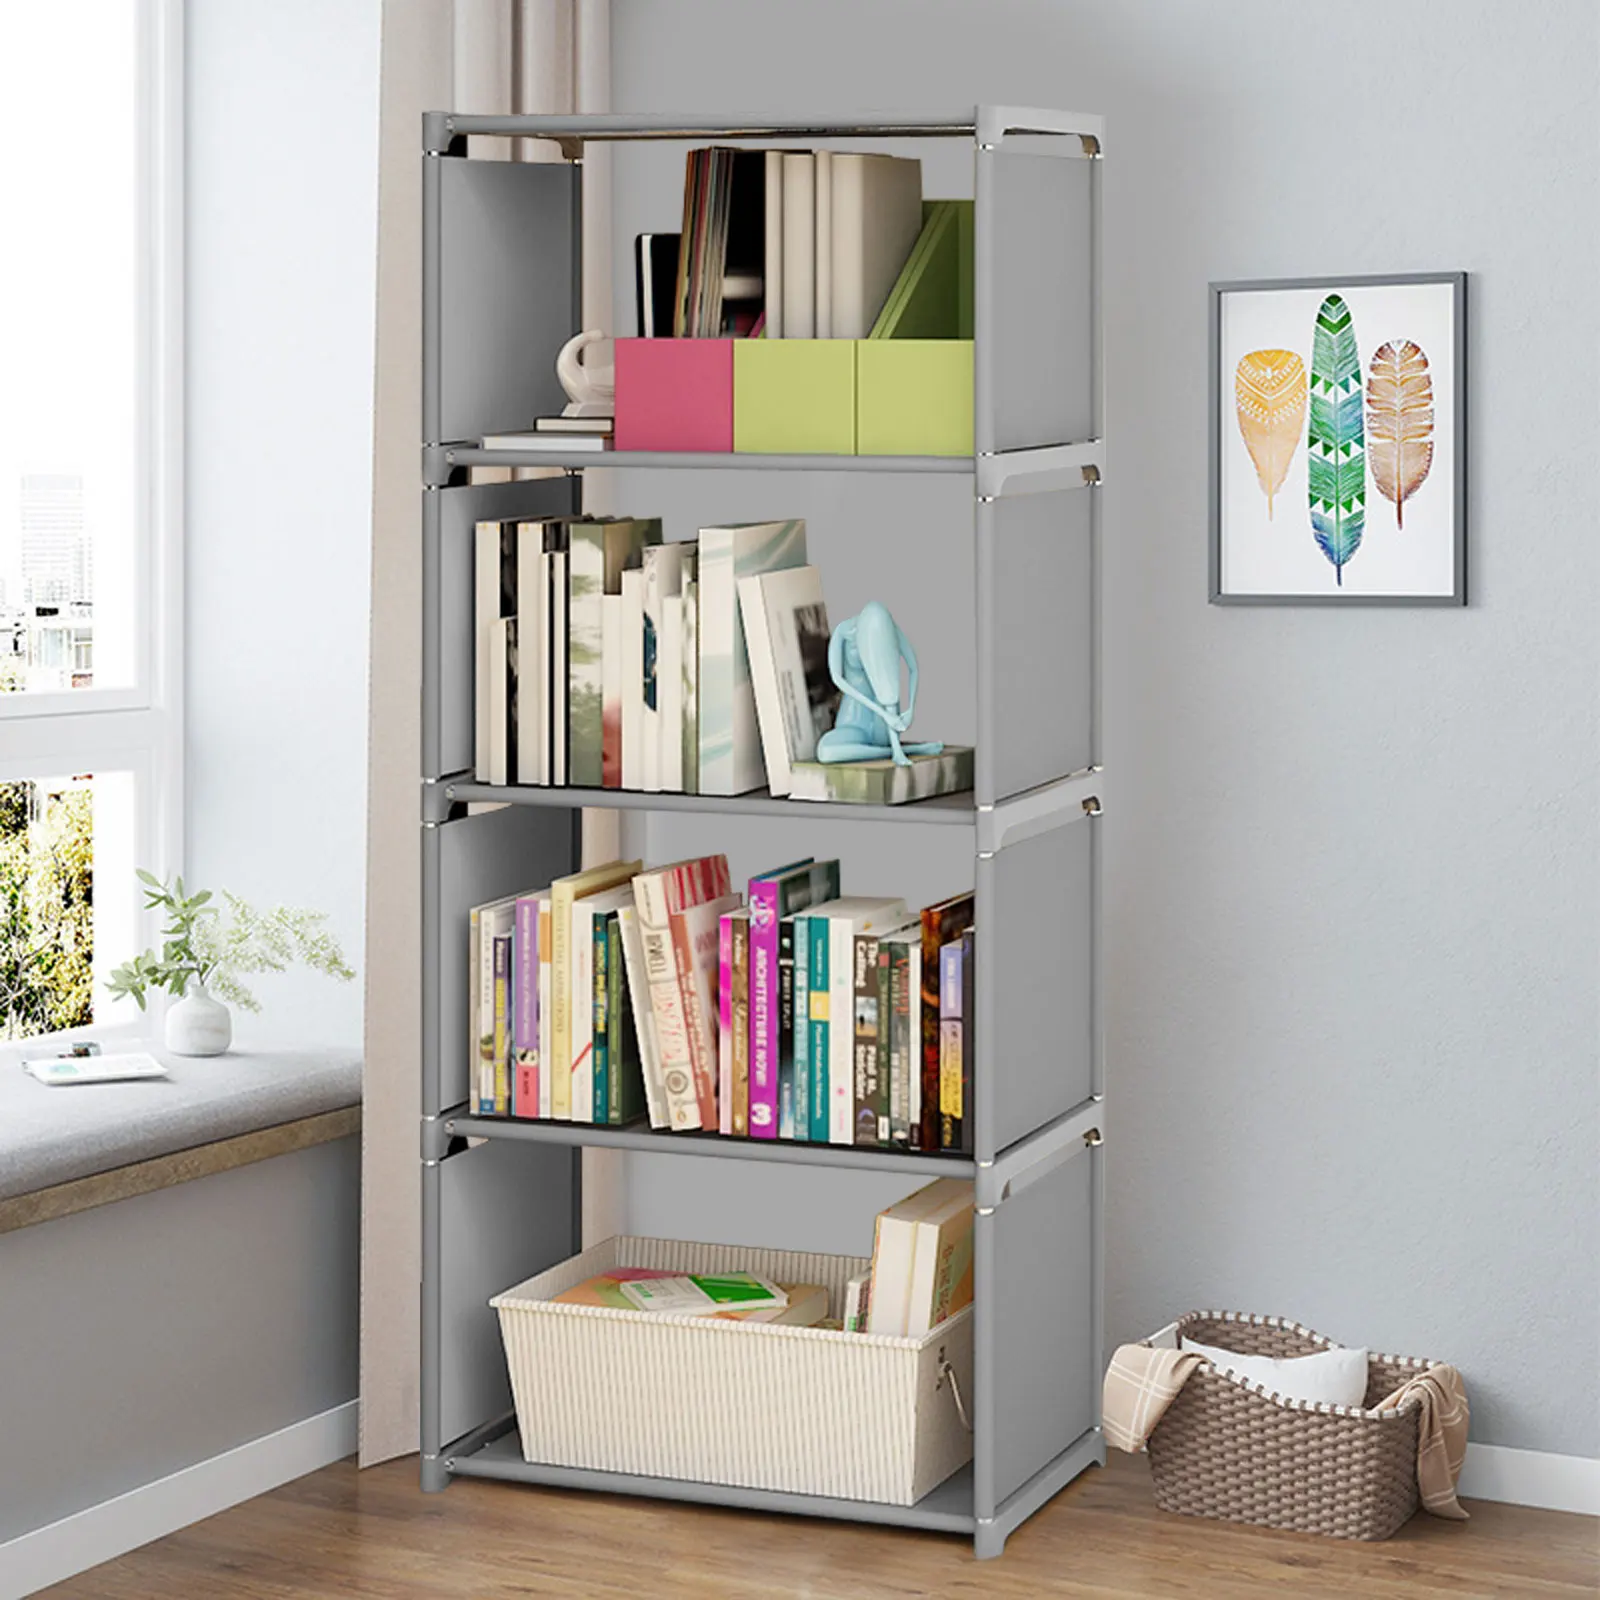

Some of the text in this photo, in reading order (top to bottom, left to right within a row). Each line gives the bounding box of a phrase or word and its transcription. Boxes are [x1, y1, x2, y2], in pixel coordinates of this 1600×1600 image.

[855, 940, 867, 988] Calling
[867, 941, 879, 968] The
[755, 946, 769, 1048] ARCHITECTURE
[867, 1044, 878, 1075] Paul
[751, 1102, 772, 1126] 3
